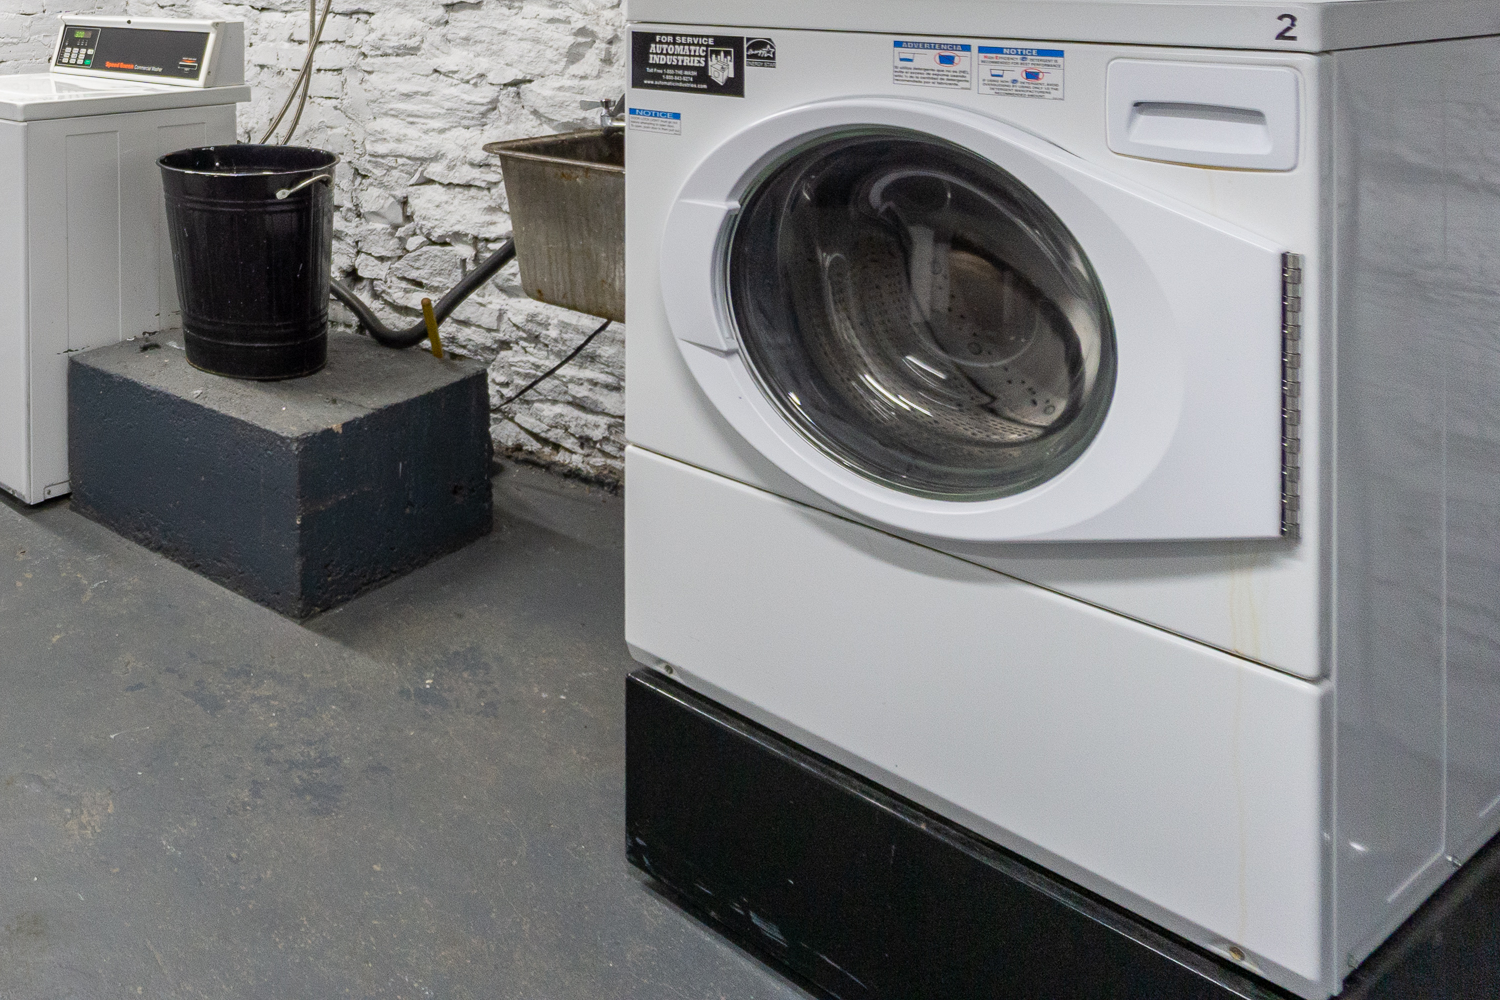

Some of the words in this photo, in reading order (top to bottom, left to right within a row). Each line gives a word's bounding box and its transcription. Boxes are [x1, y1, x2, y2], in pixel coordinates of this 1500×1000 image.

[1275, 14, 1298, 41] 2
[676, 37, 714, 45] SERVICE
[650, 44, 706, 56] AUTOMATIC
[902, 42, 962, 51] ADVERTENCIA
[648, 54, 706, 67] INDUSTRIES
[644, 80, 708, 88] www.automaticindustries.com
[636, 109, 674, 119] NOTICE
